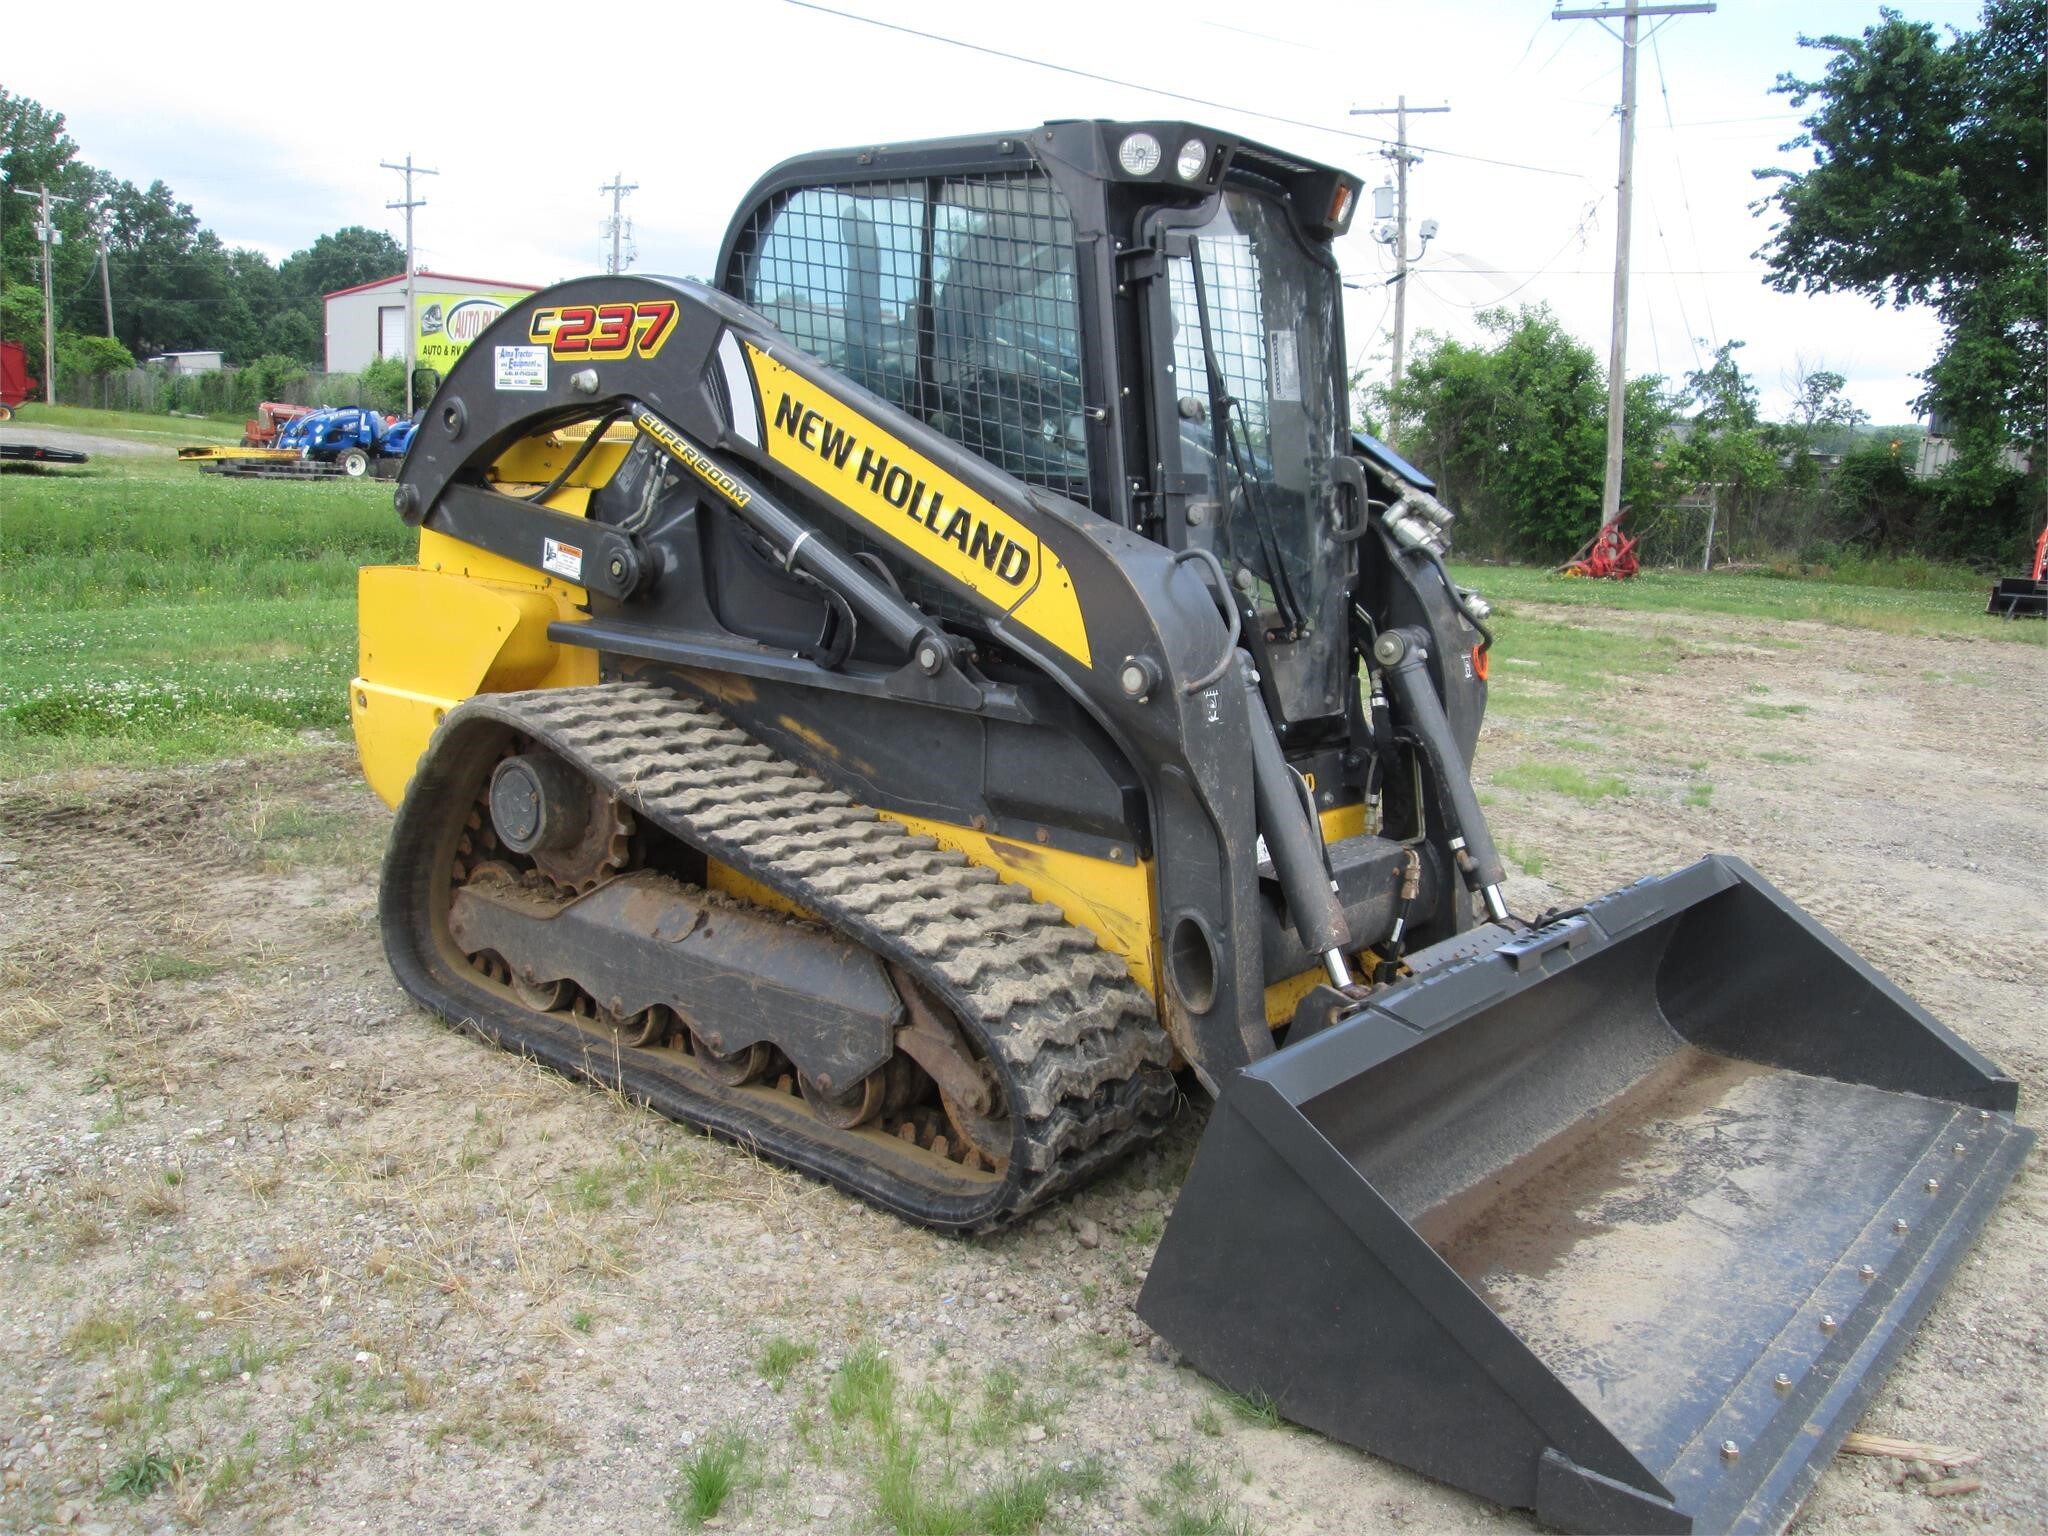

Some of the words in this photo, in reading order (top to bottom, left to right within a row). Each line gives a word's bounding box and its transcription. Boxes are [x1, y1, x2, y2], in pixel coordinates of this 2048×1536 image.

[454, 310, 480, 339] AUTO
[530, 301, 678, 360] C237
[423, 345, 442, 355] AUTO
[443, 345, 449, 355] &
[450, 345, 461, 356] RV
[774, 391, 856, 470] NEW
[856, 446, 1030, 587] HOLLAND
